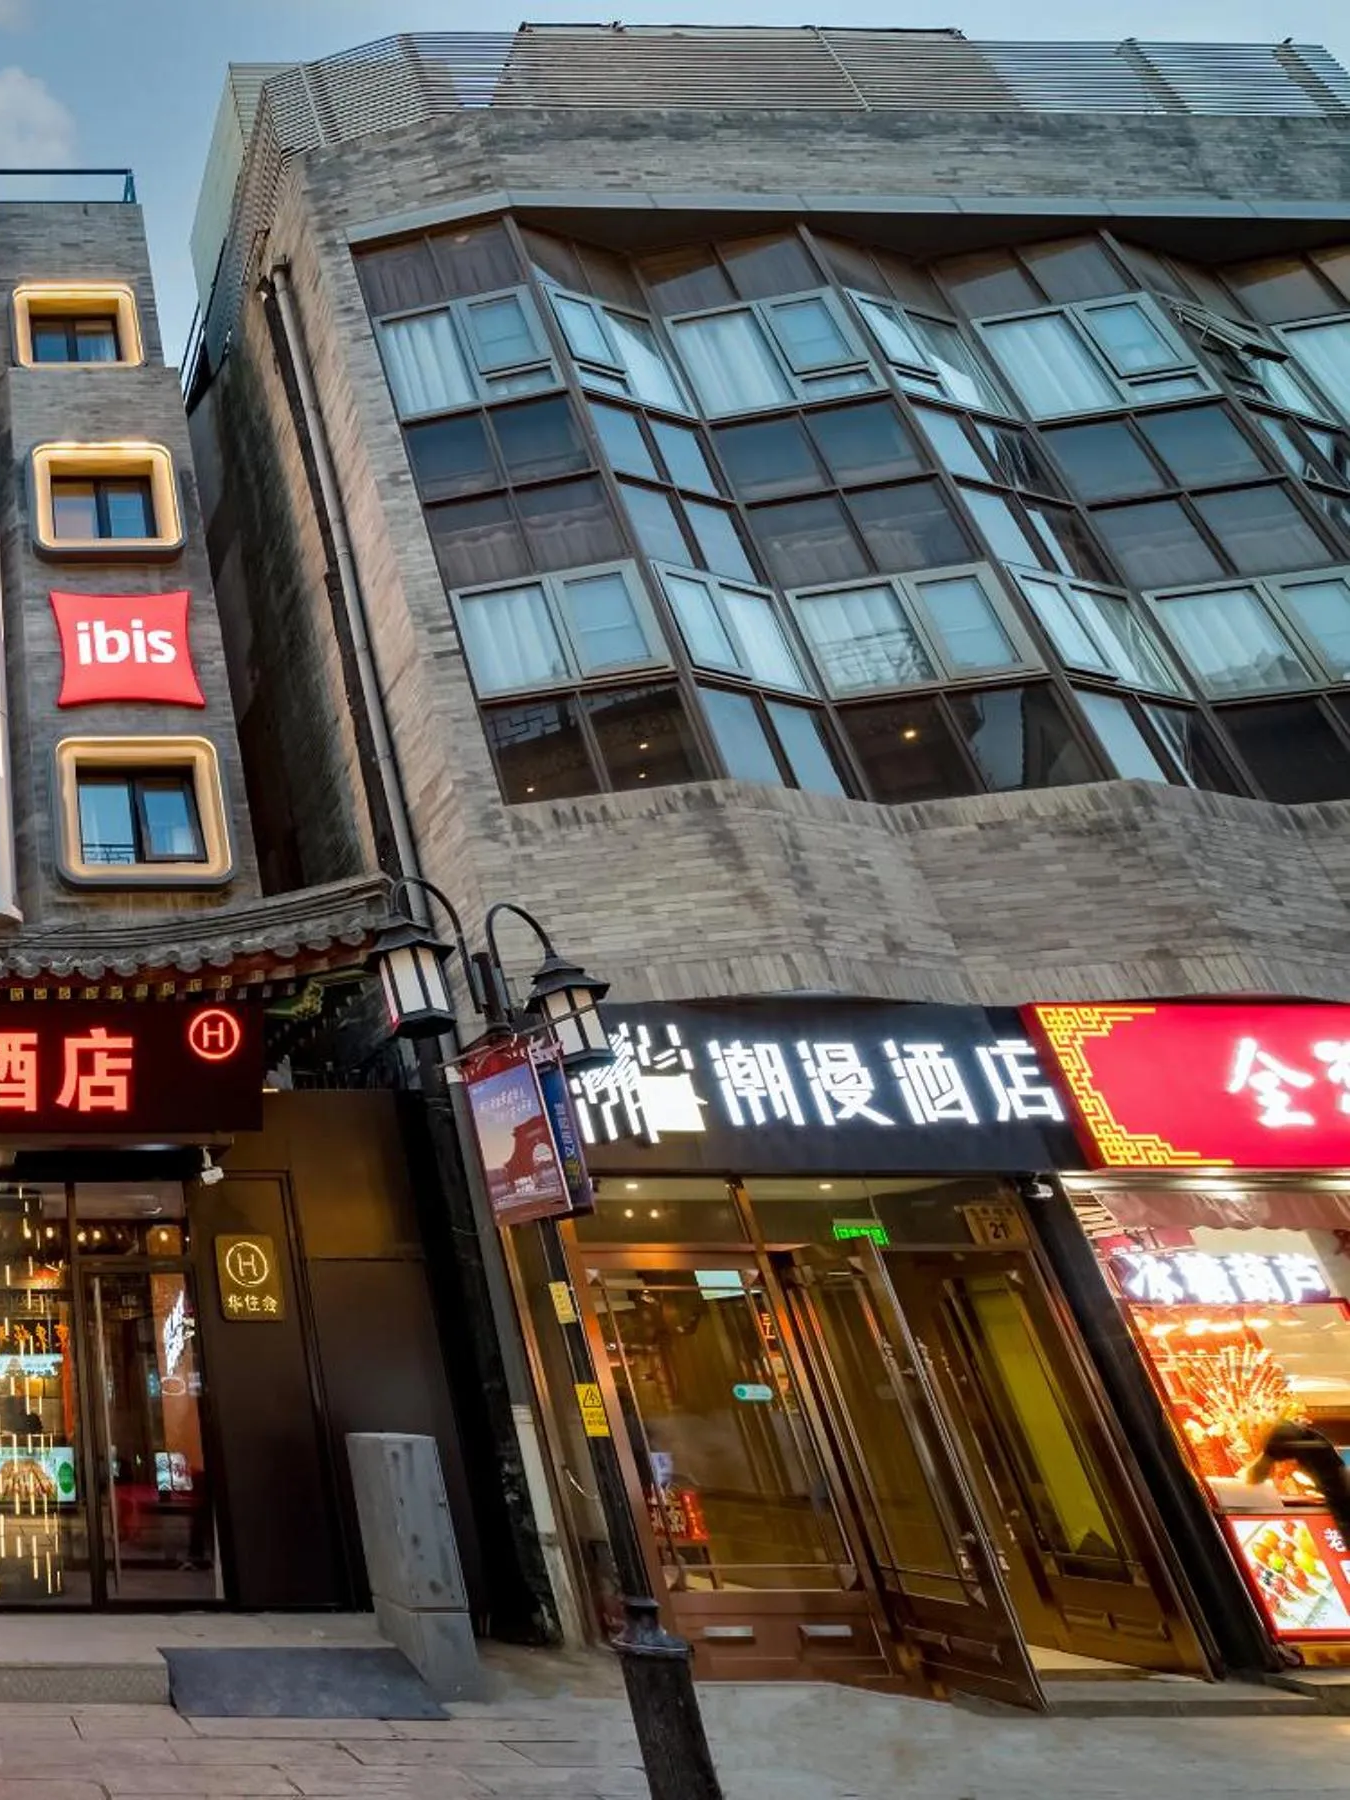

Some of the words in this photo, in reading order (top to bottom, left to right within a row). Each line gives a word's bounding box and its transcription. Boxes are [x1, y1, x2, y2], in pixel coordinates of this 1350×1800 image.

[77, 619, 176, 664] ibis
[706, 1038, 1066, 1126] 潮漫酒店
[989, 1221, 1009, 1239] 21
[228, 1294, 278, 1313] 华住会
